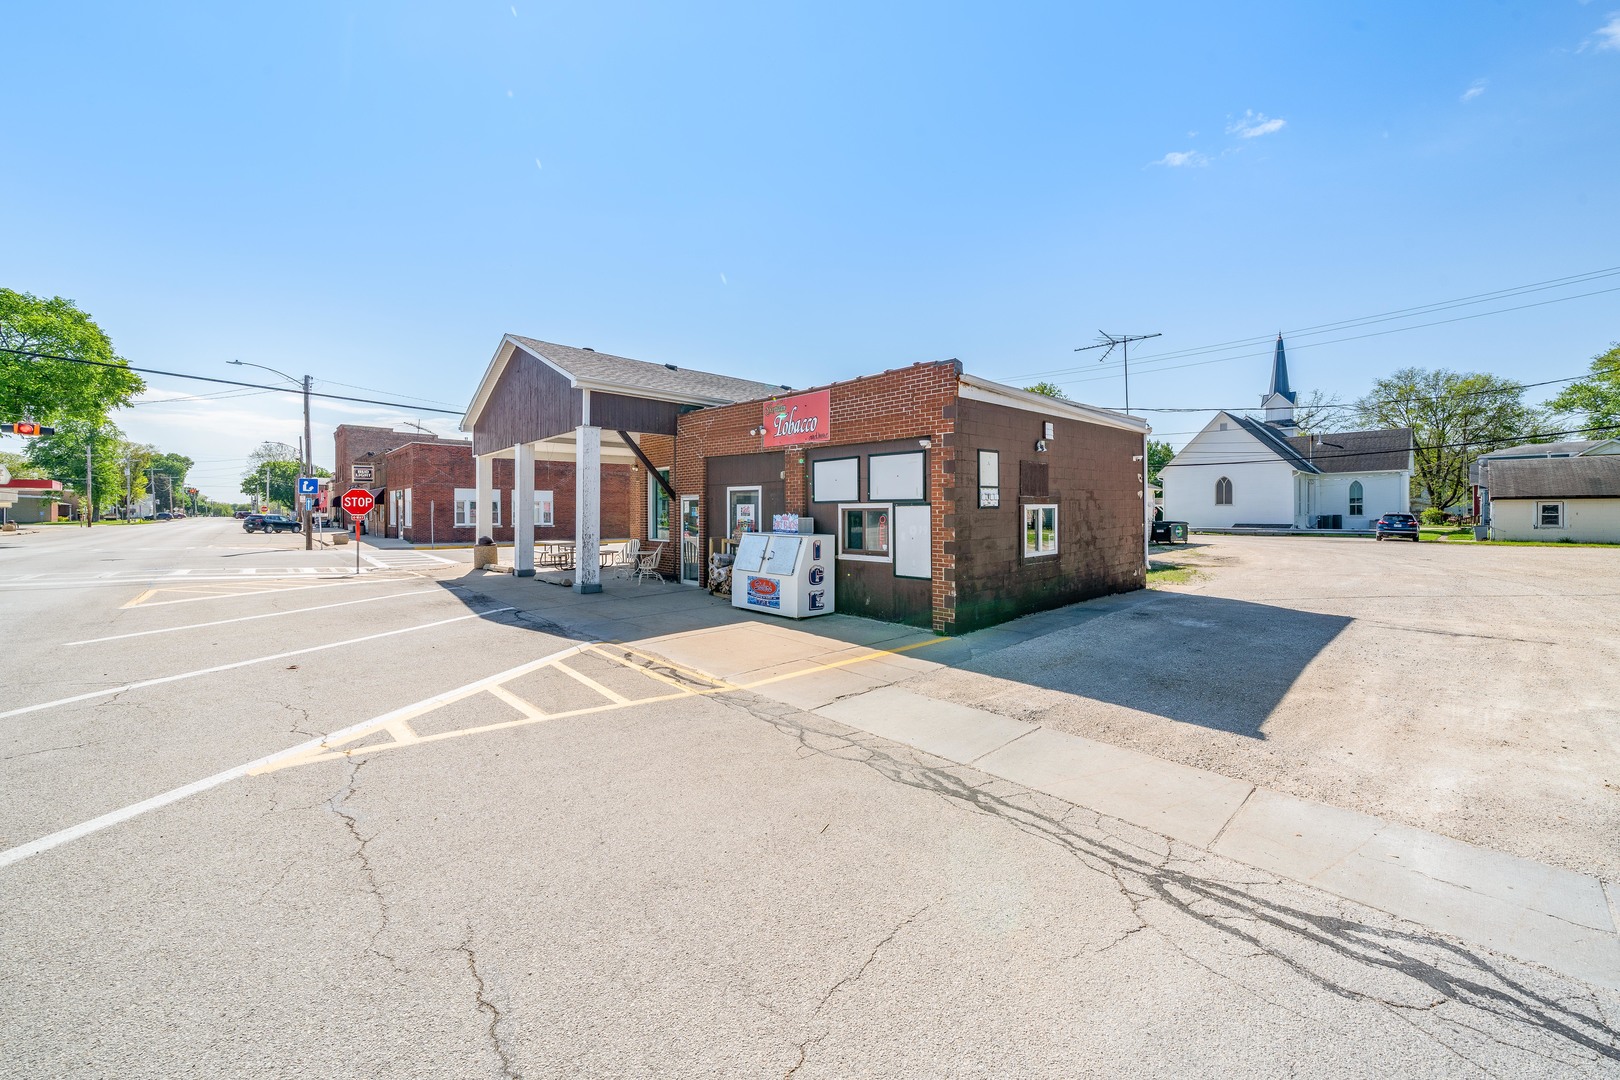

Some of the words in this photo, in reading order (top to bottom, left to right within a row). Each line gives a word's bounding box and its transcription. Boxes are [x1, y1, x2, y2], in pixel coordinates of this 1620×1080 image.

[773, 405, 818, 438] Tobacco
[344, 497, 372, 507] STOP
[809, 540, 824, 611] ICE
